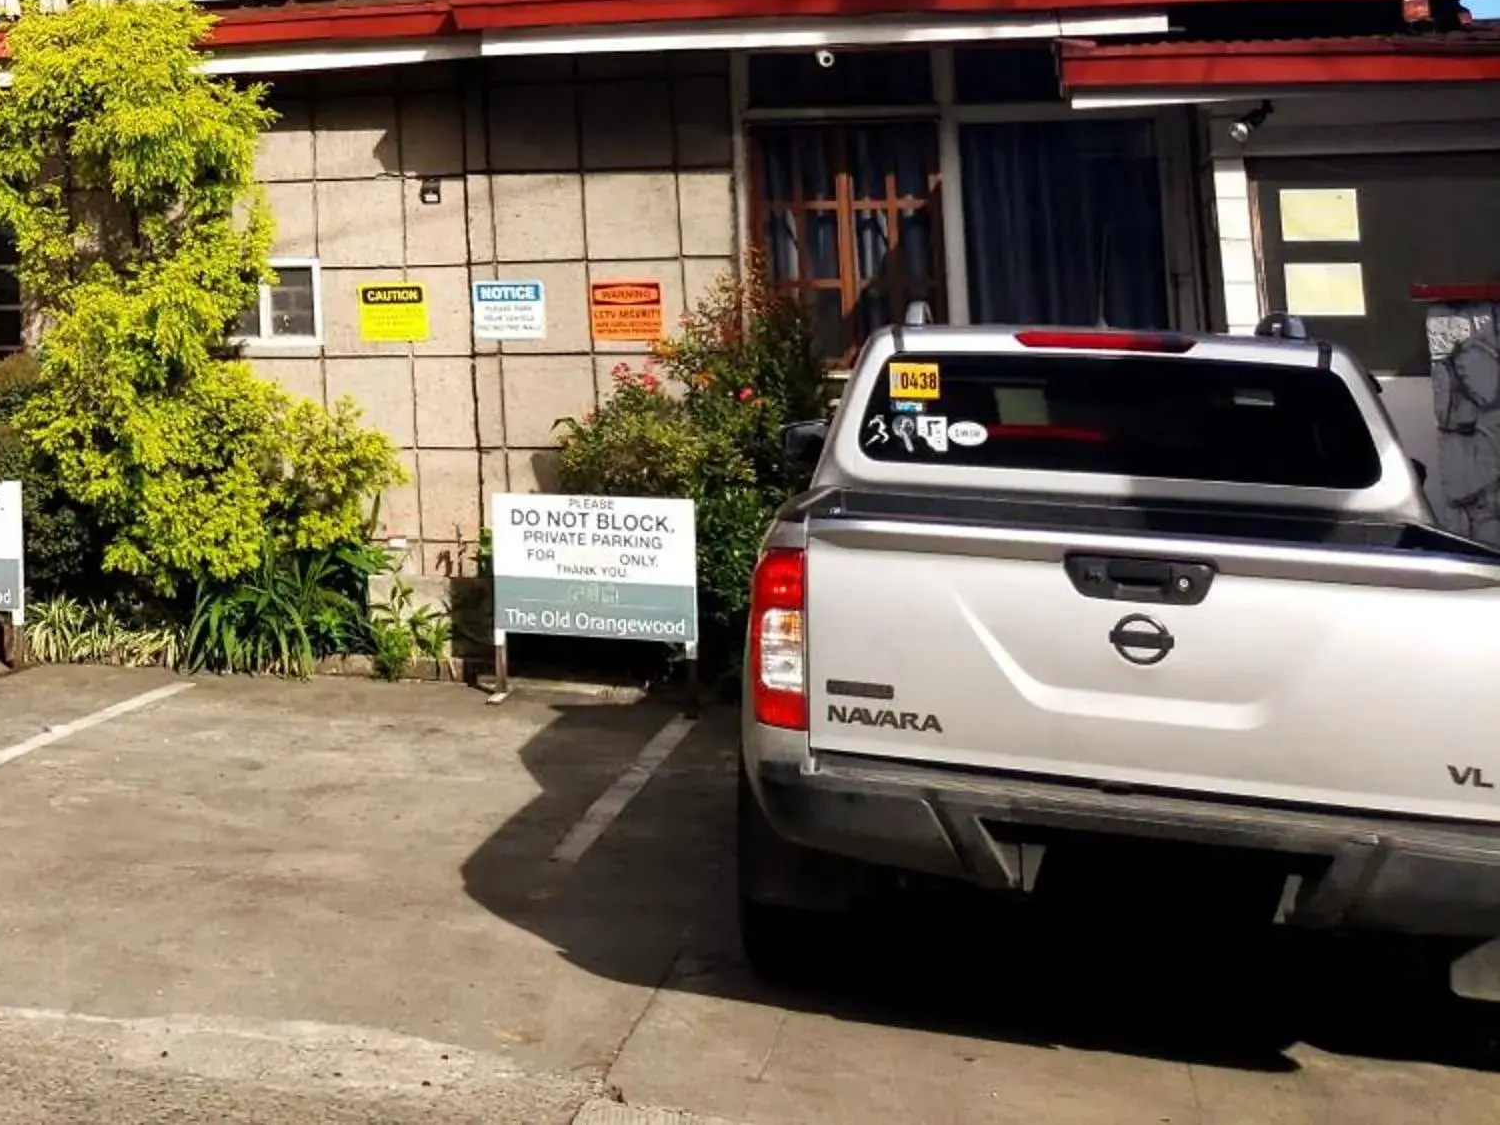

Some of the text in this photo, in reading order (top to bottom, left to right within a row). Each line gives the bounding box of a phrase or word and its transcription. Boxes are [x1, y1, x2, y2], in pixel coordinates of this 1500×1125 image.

[366, 288, 419, 302] CAUTION
[479, 285, 537, 300] NOTICE
[900, 372, 938, 390] 0438
[568, 498, 615, 511] PLEASE
[510, 508, 541, 527] DO
[547, 510, 590, 529] NOT
[523, 530, 664, 551] PRIVATE PARKING
[527, 548, 556, 562] FOR
[557, 563, 598, 576] THANK
[504, 607, 686, 636] The Old Orangewood
[827, 704, 943, 734] NAVARA
[1446, 764, 1495, 789] VL
